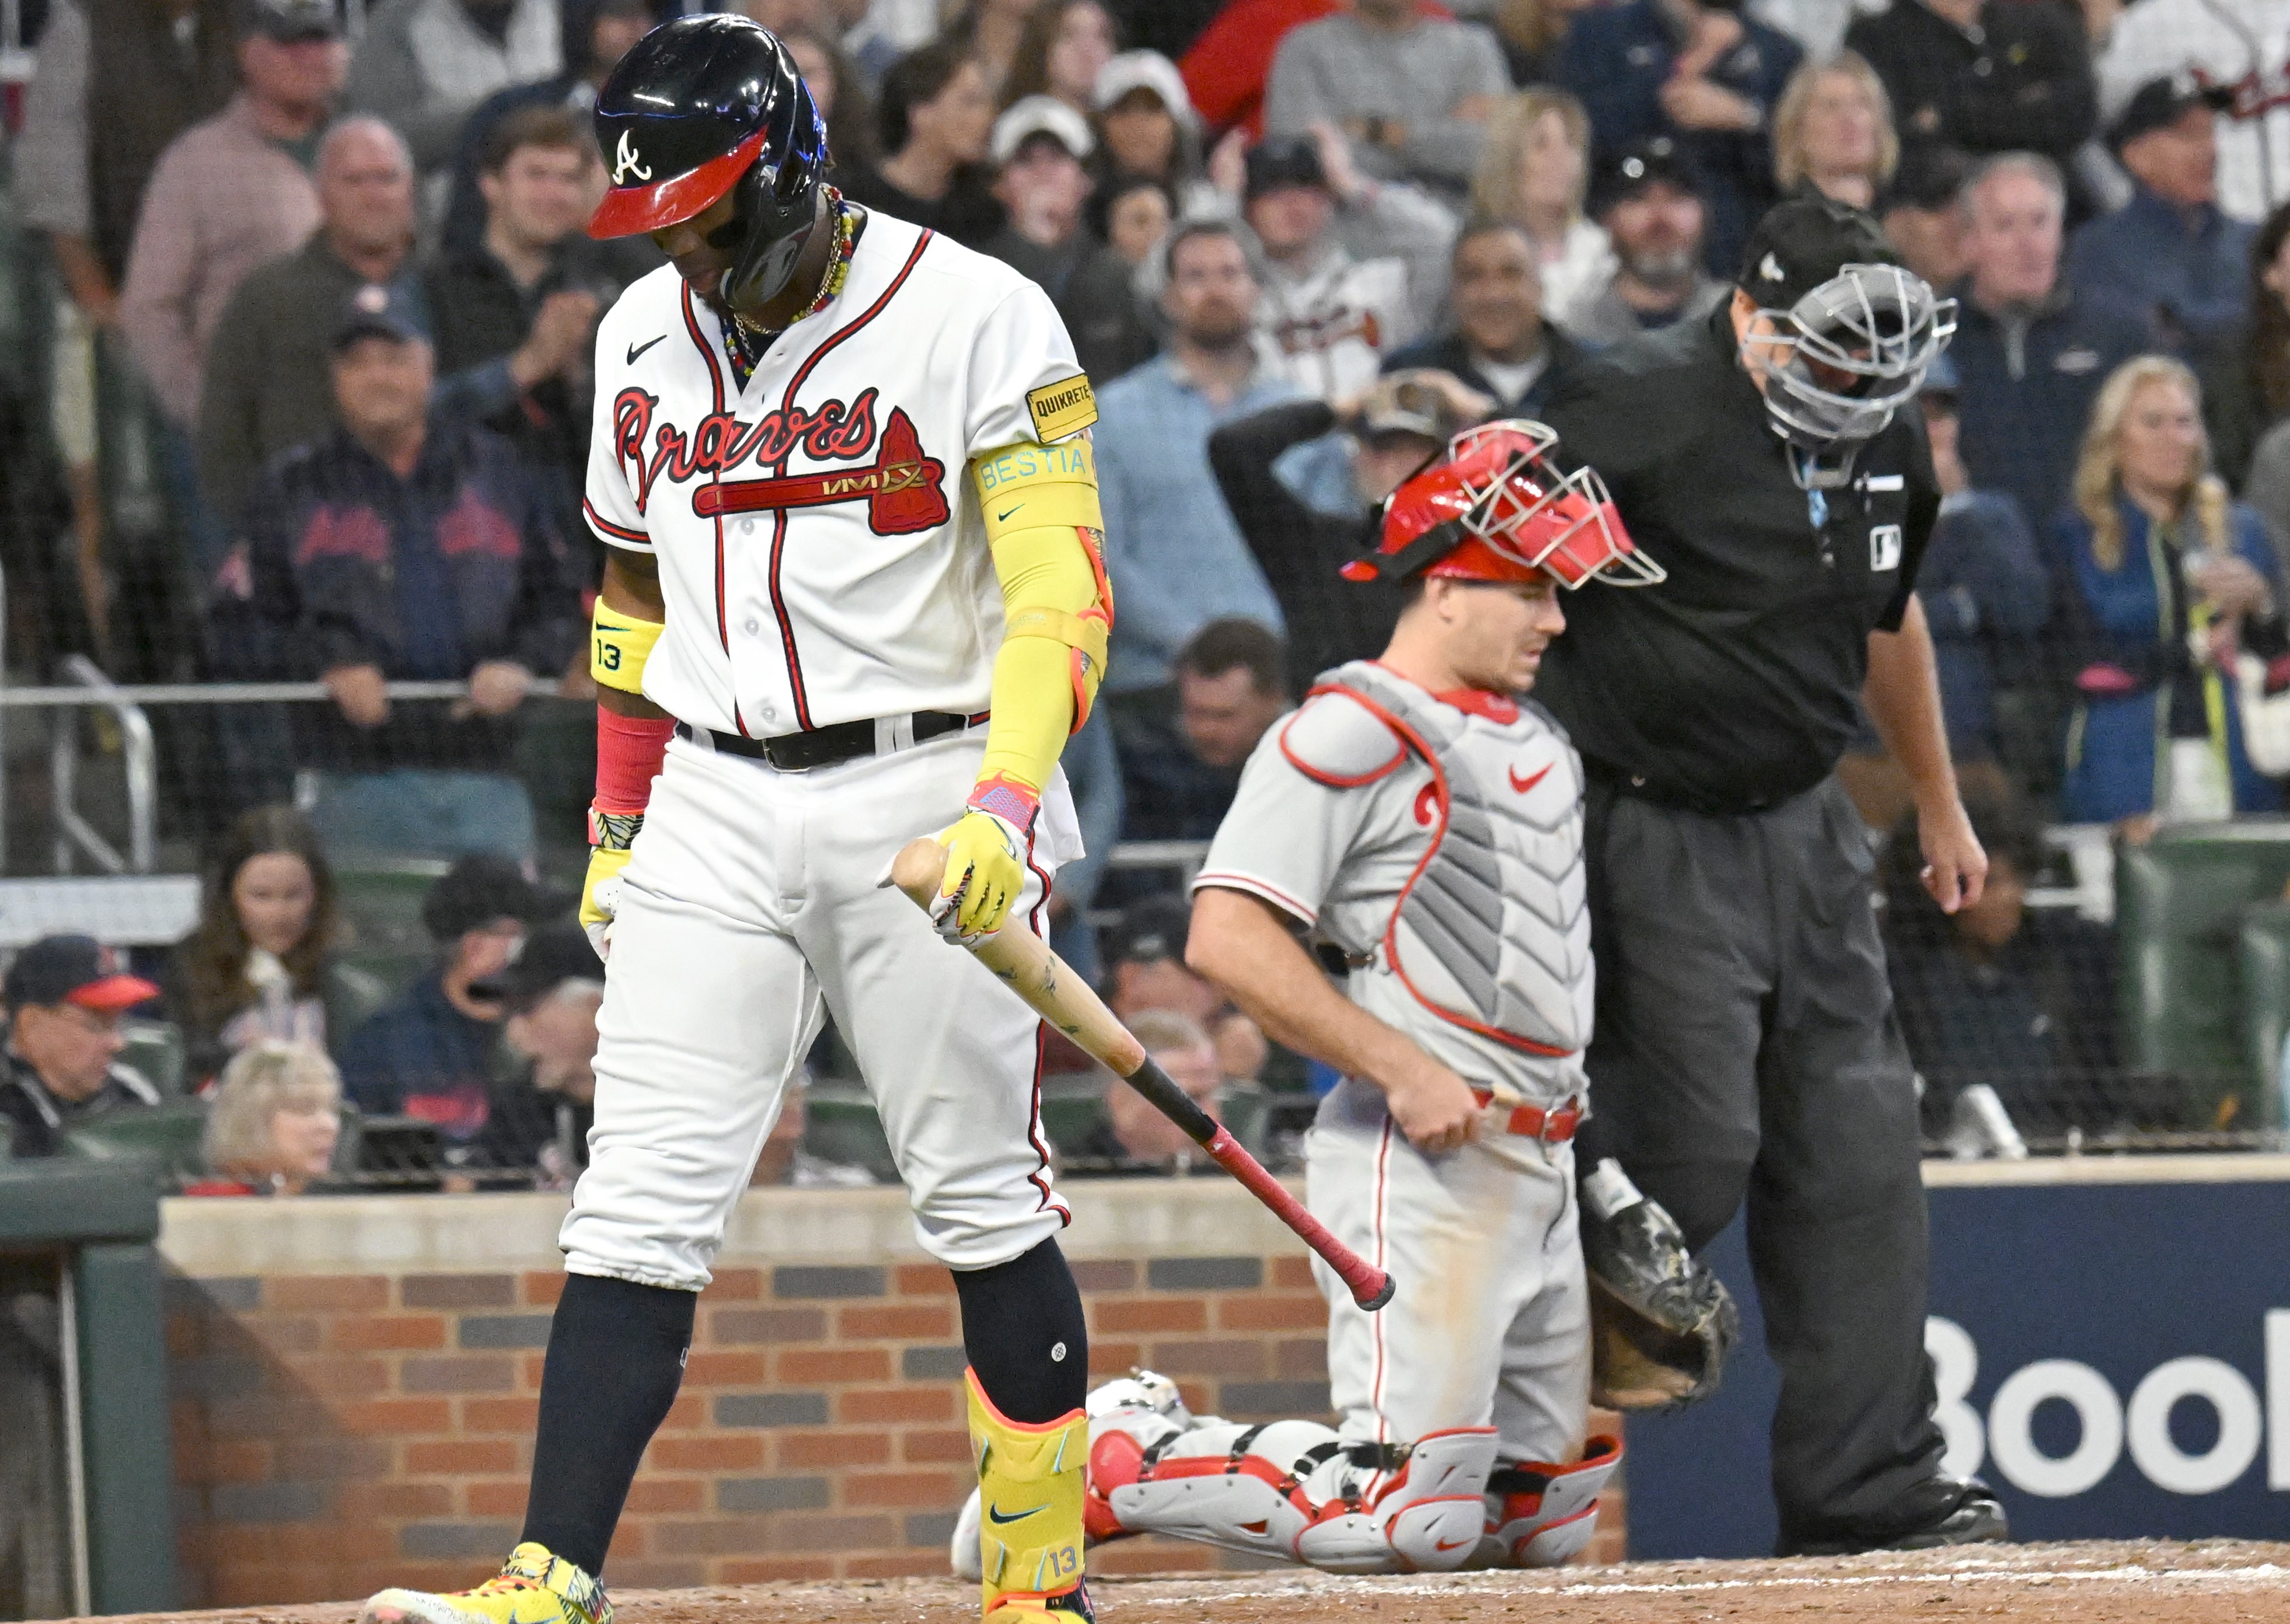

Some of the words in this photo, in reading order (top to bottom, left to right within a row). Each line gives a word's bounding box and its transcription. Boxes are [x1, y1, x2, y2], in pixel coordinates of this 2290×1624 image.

[612, 130, 652, 185] A
[1035, 385, 1090, 417] QUIKRETE
[613, 387, 879, 518] Braves
[980, 448, 1086, 490] BESTIA
[597, 638, 621, 671] 13
[1050, 1546, 1076, 1578] 13
